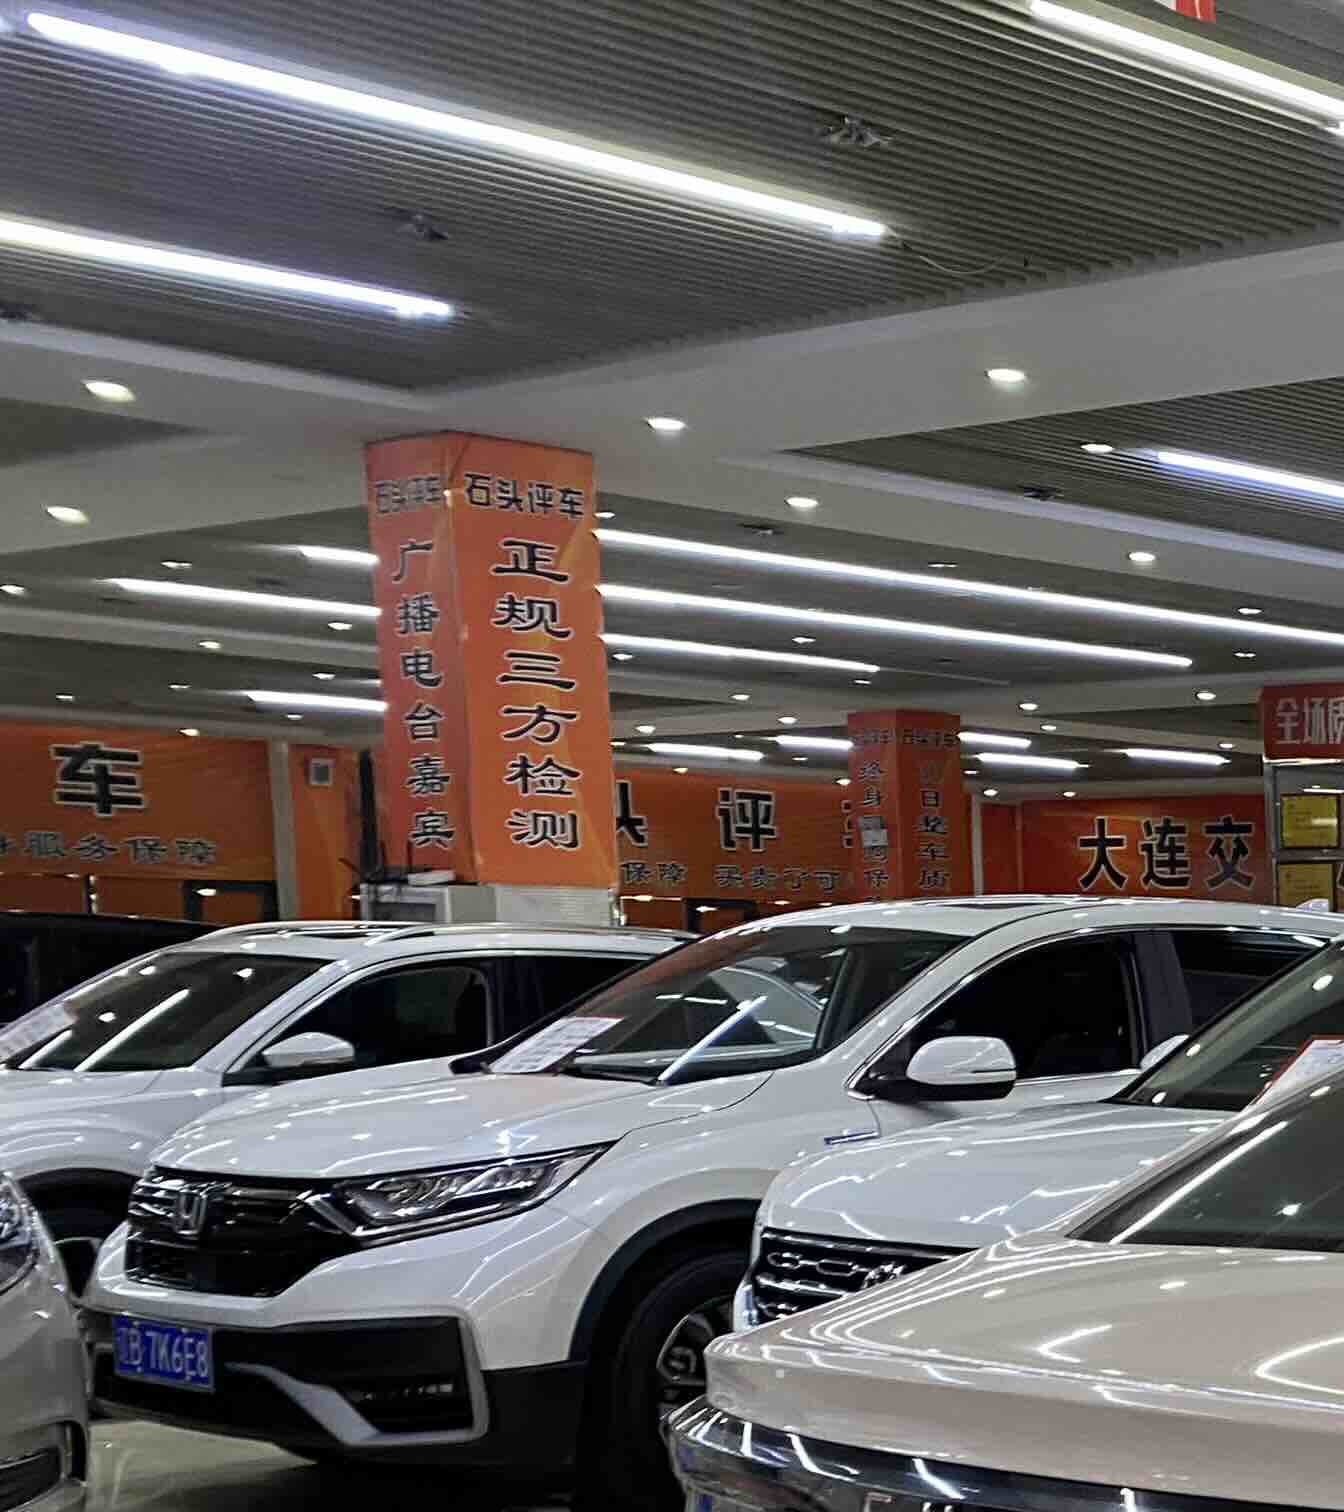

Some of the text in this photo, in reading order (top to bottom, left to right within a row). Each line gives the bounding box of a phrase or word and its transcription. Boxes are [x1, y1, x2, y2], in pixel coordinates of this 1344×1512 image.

[464, 471, 586, 521] 石头评车
[391, 534, 458, 852] 广播电台嘉宾
[491, 535, 581, 850] 正规三方检测
[49, 740, 147, 817] 车
[1078, 815, 1258, 893] 大连交
